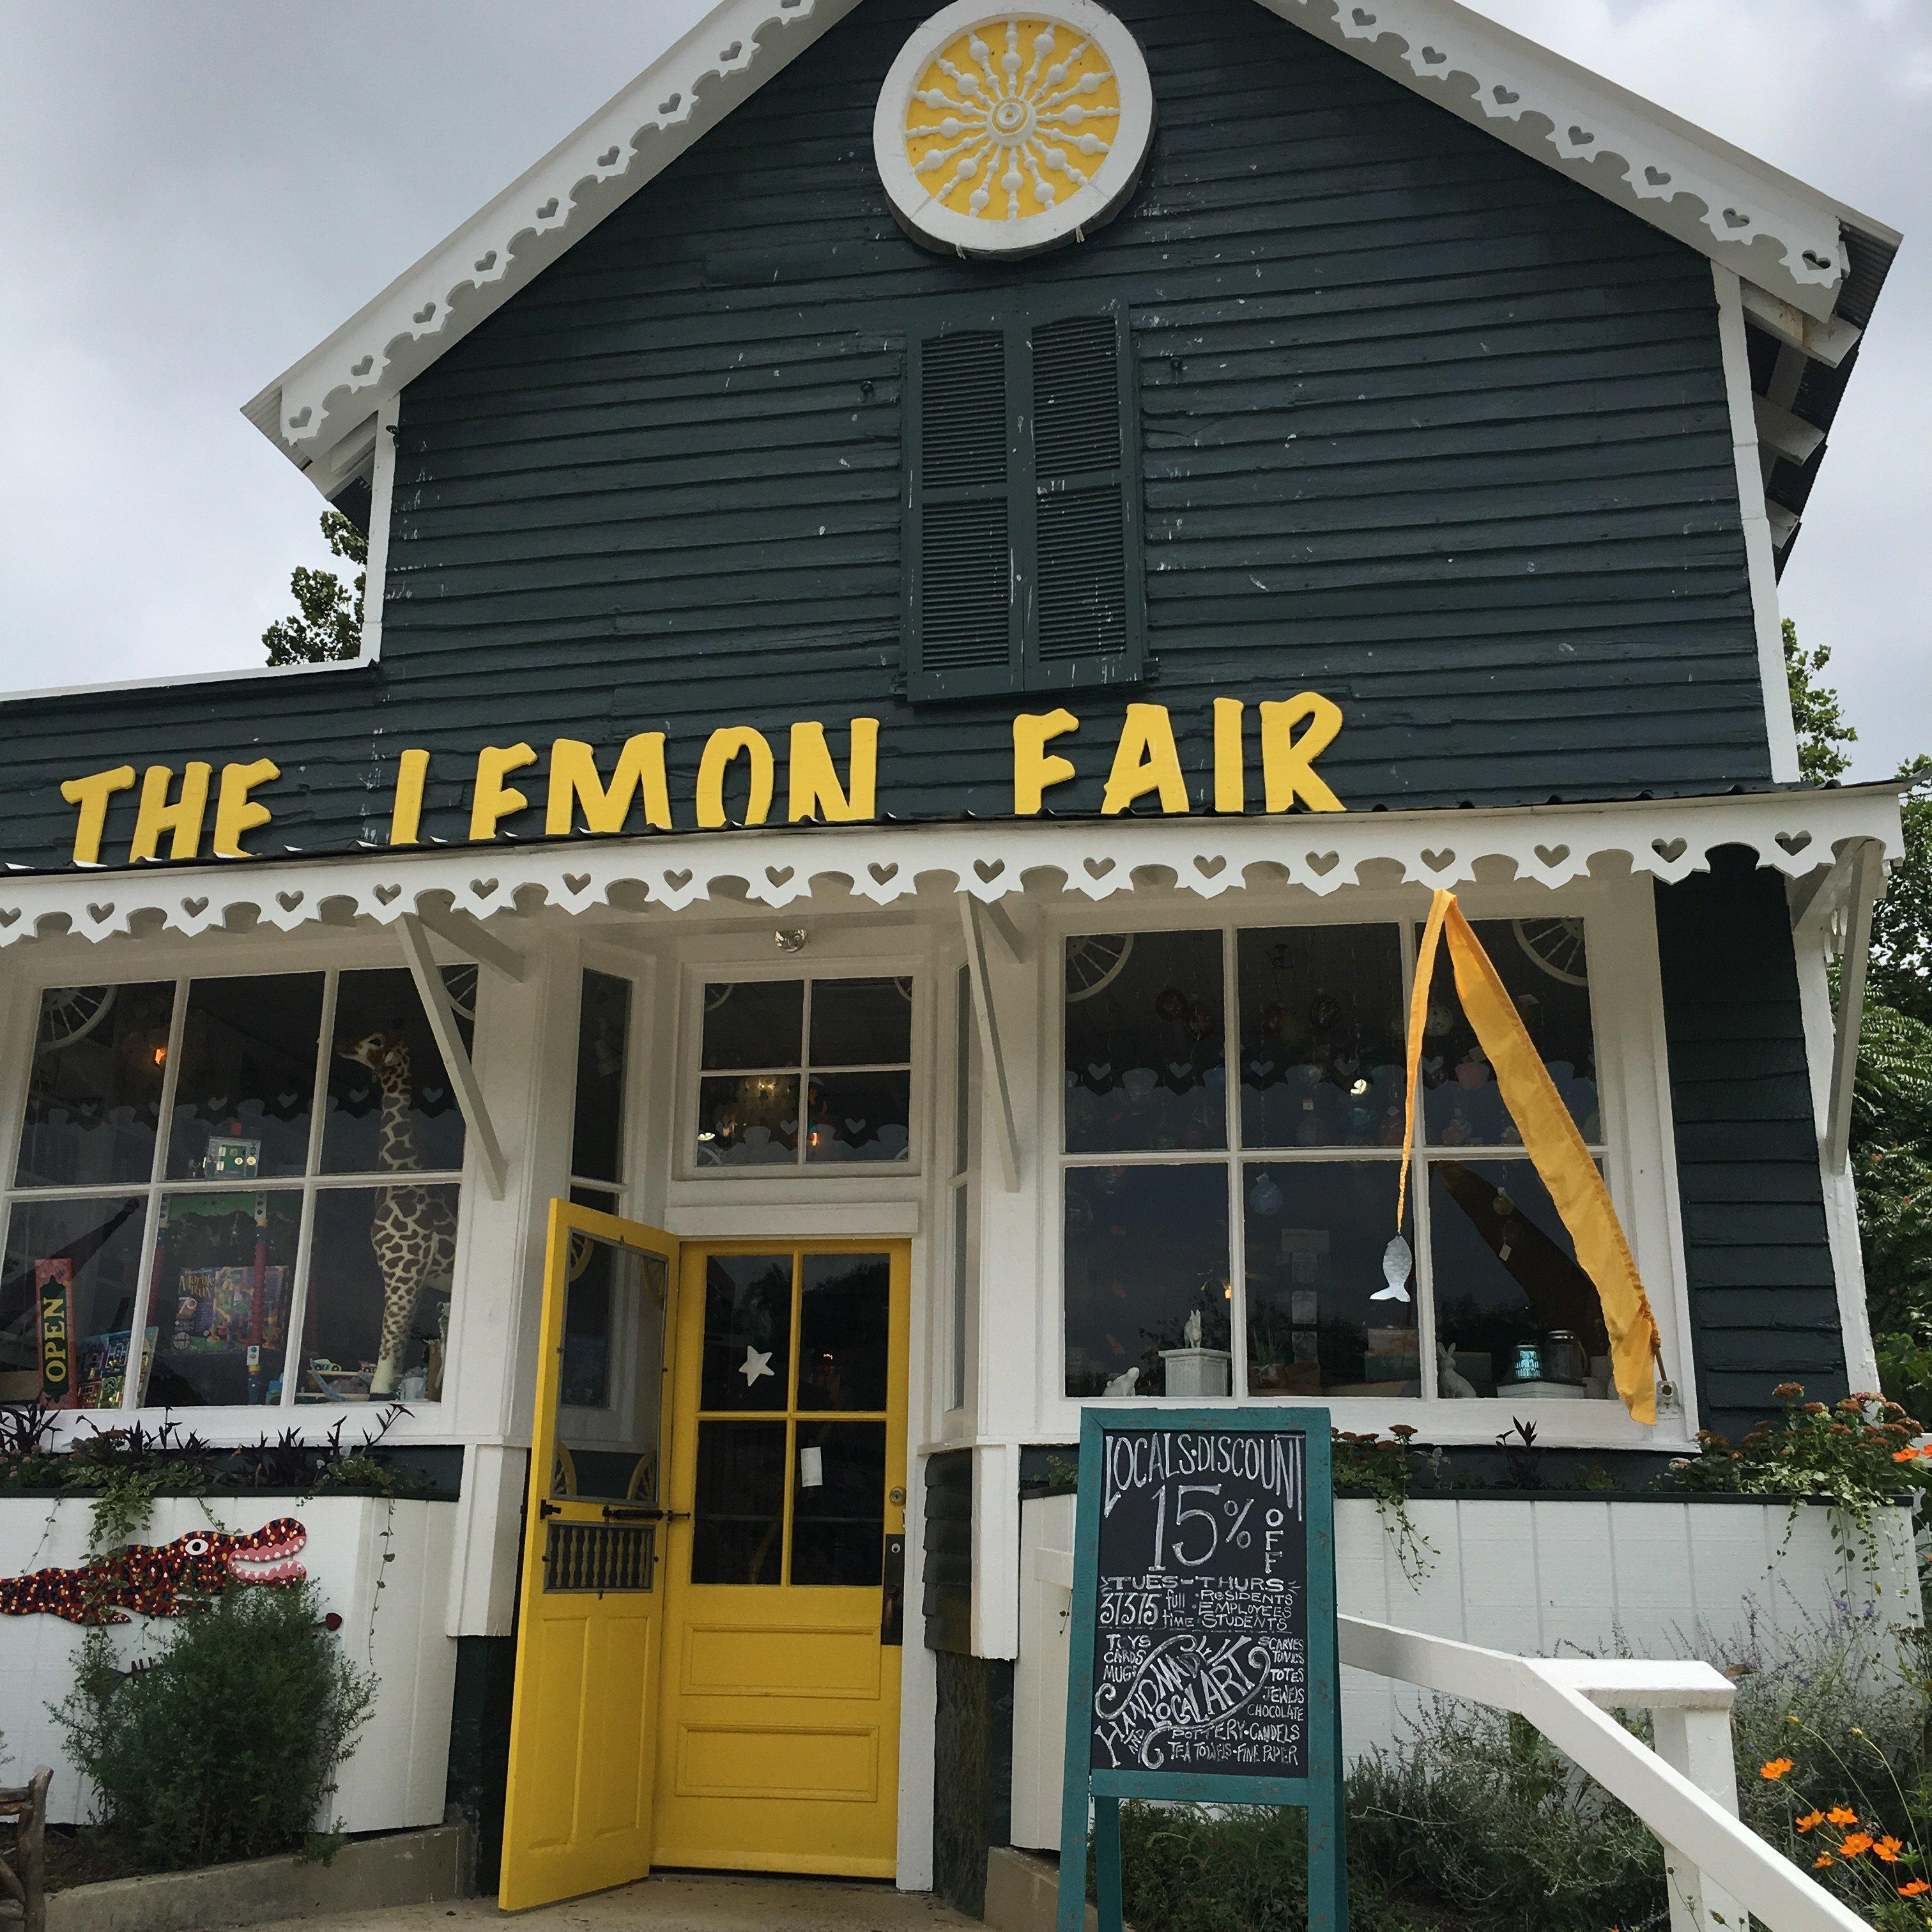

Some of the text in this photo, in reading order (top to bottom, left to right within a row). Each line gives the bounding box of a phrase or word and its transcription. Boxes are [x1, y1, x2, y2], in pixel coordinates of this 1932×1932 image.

[60, 758, 282, 863] THE
[1013, 691, 1347, 815] FAIR
[179, 1296, 197, 1314] 70
[43, 1297, 66, 1383] OPEN
[1148, 1483, 1284, 1574] 15% OFF
[1100, 1588, 1186, 1625] 37375 full
[1199, 1600, 1292, 1619] EMPLOYEES
[1201, 1613, 1288, 1630] STUDENTS
[1257, 1636, 1305, 1651] SCARVES
[1103, 1648, 1147, 1666] CARDS
[1271, 1650, 1305, 1665] TUNICS
[1103, 1664, 1138, 1683] MUGS
[1147, 1635, 1255, 1728] LOCAL ART
[1269, 1667, 1305, 1683] TOTES
[1262, 1684, 1305, 1704] JEWELS
[1247, 1703, 1304, 1722] CHOCOLATE
[1167, 1740, 1192, 1763] TEA
[1262, 1744, 1298, 1766] PAPER
